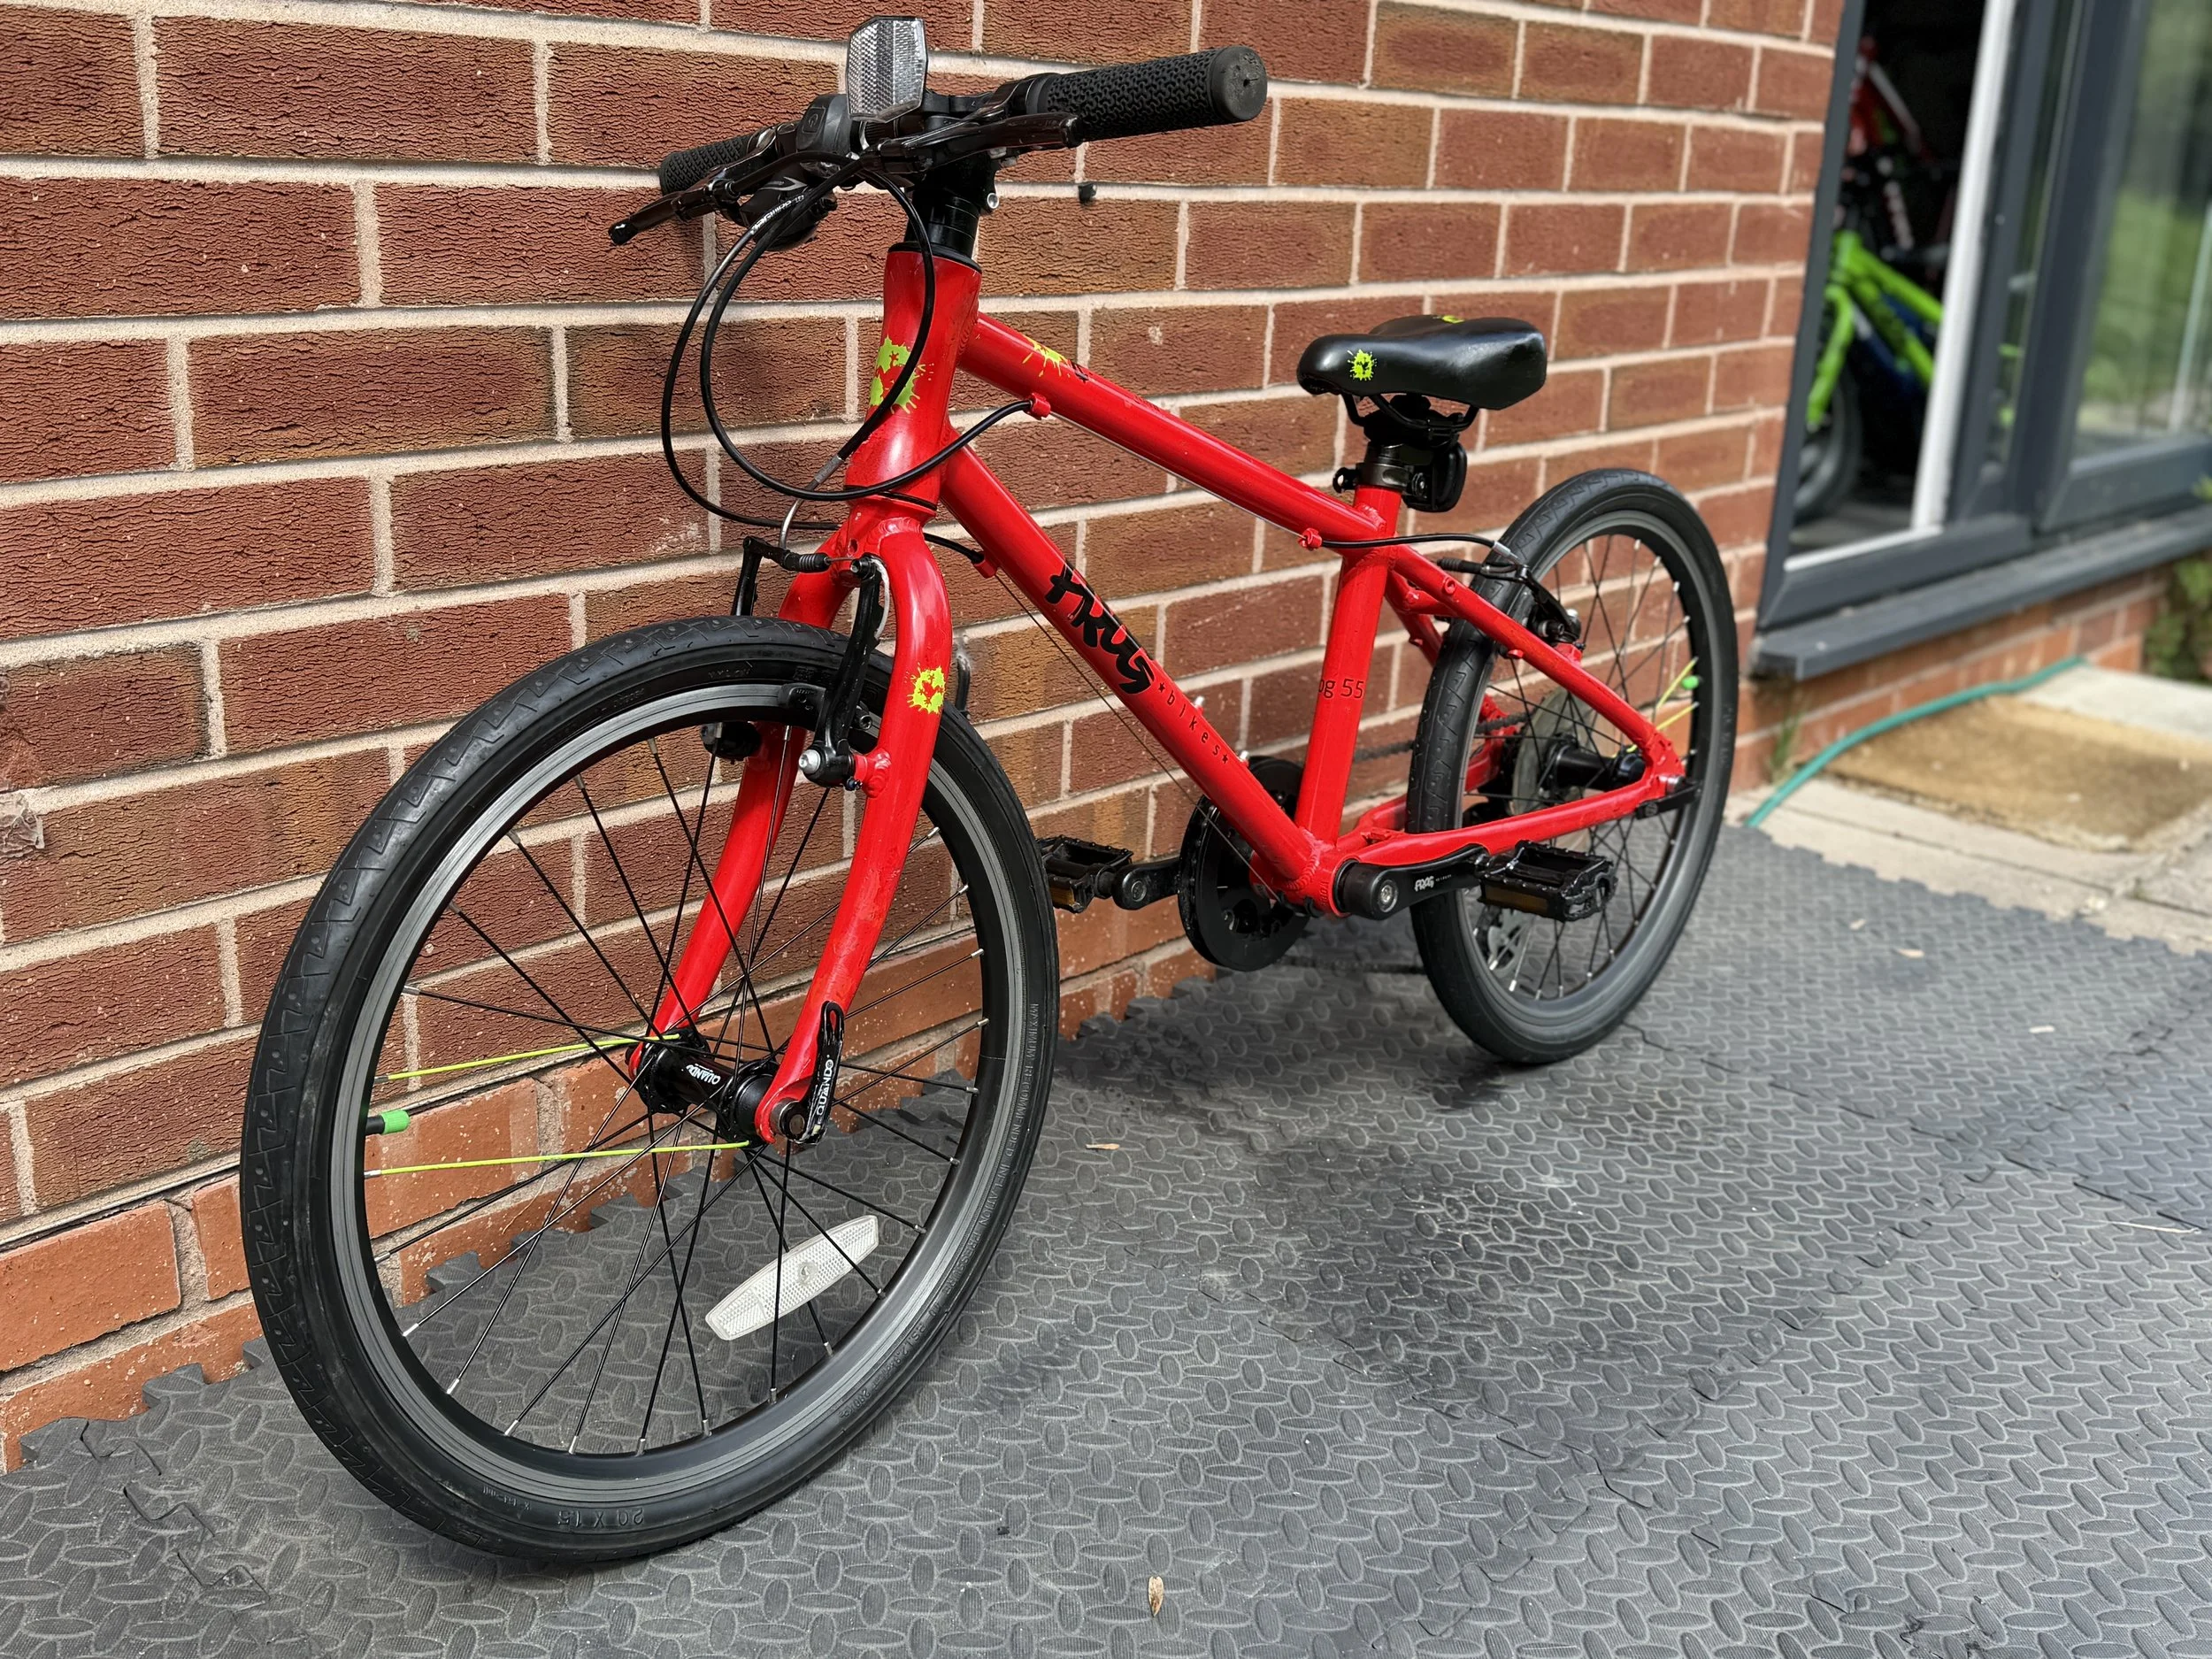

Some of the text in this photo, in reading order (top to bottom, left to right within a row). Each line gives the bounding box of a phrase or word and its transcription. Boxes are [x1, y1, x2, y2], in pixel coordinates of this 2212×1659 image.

[1340, 678, 1364, 699] 55
[1026, 1003, 1039, 1059] MAXIMUM
[817, 1059, 833, 1115] QUANDO
[1005, 1065, 1033, 1157] RECOMMENDED
[979, 1164, 1010, 1226] INFLATION
[941, 1233, 981, 1295] PRESSURE
[617, 1507, 644, 1526] 20
